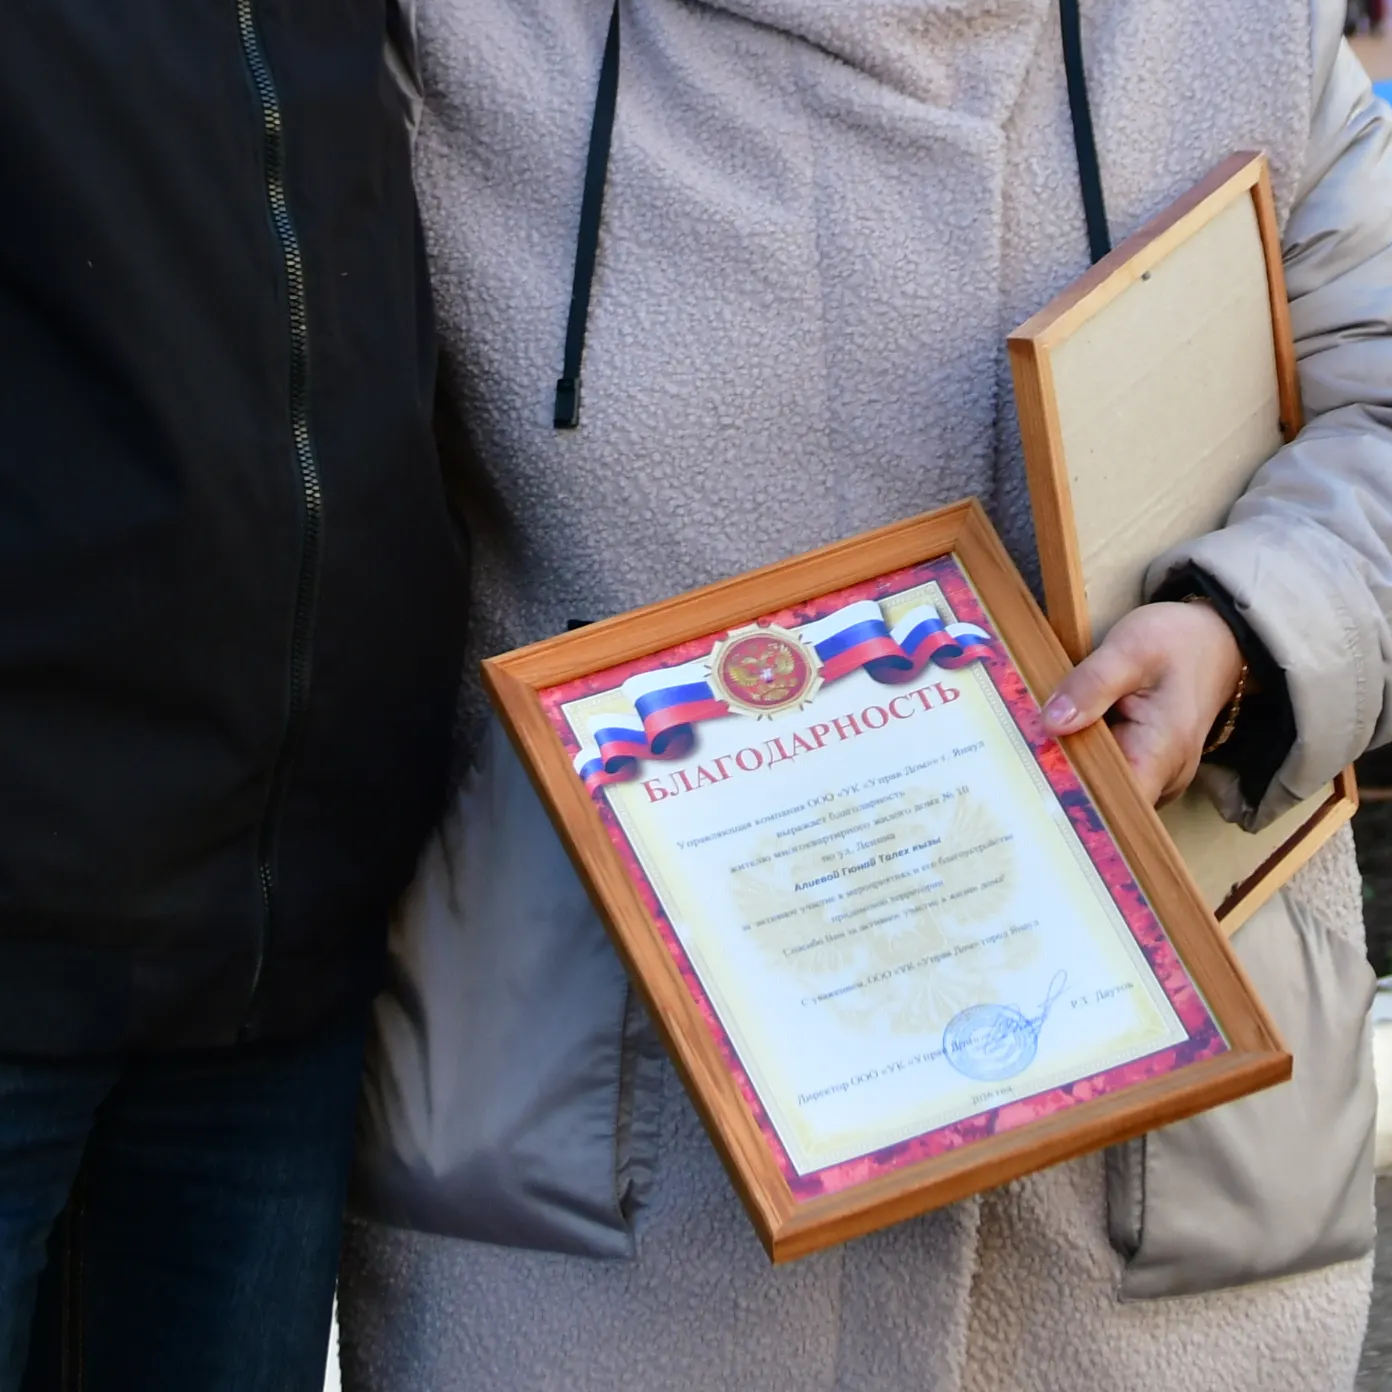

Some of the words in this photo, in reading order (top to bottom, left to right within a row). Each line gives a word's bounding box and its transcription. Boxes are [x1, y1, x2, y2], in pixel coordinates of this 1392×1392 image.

[643, 682, 959, 802] БЛАГОДАРНОСТЬ
[675, 821, 752, 850] Управляющая
[753, 803, 806, 826] компания
[805, 792, 835, 808] ООО
[728, 855, 772, 874] жителю
[772, 822, 870, 858] многоквартирного
[872, 808, 912, 826] жилого
[913, 797, 940, 812] дома
[955, 784, 970, 796] 10
[775, 815, 827, 839] выражает
[827, 790, 906, 820] благодарность
[793, 869, 840, 892] Алиевой
[911, 836, 942, 852] кызы
[820, 853, 836, 863] по
[855, 832, 896, 851] Ленина
[796, 1081, 850, 1106] Директор
[849, 1069, 879, 1085] ООО
